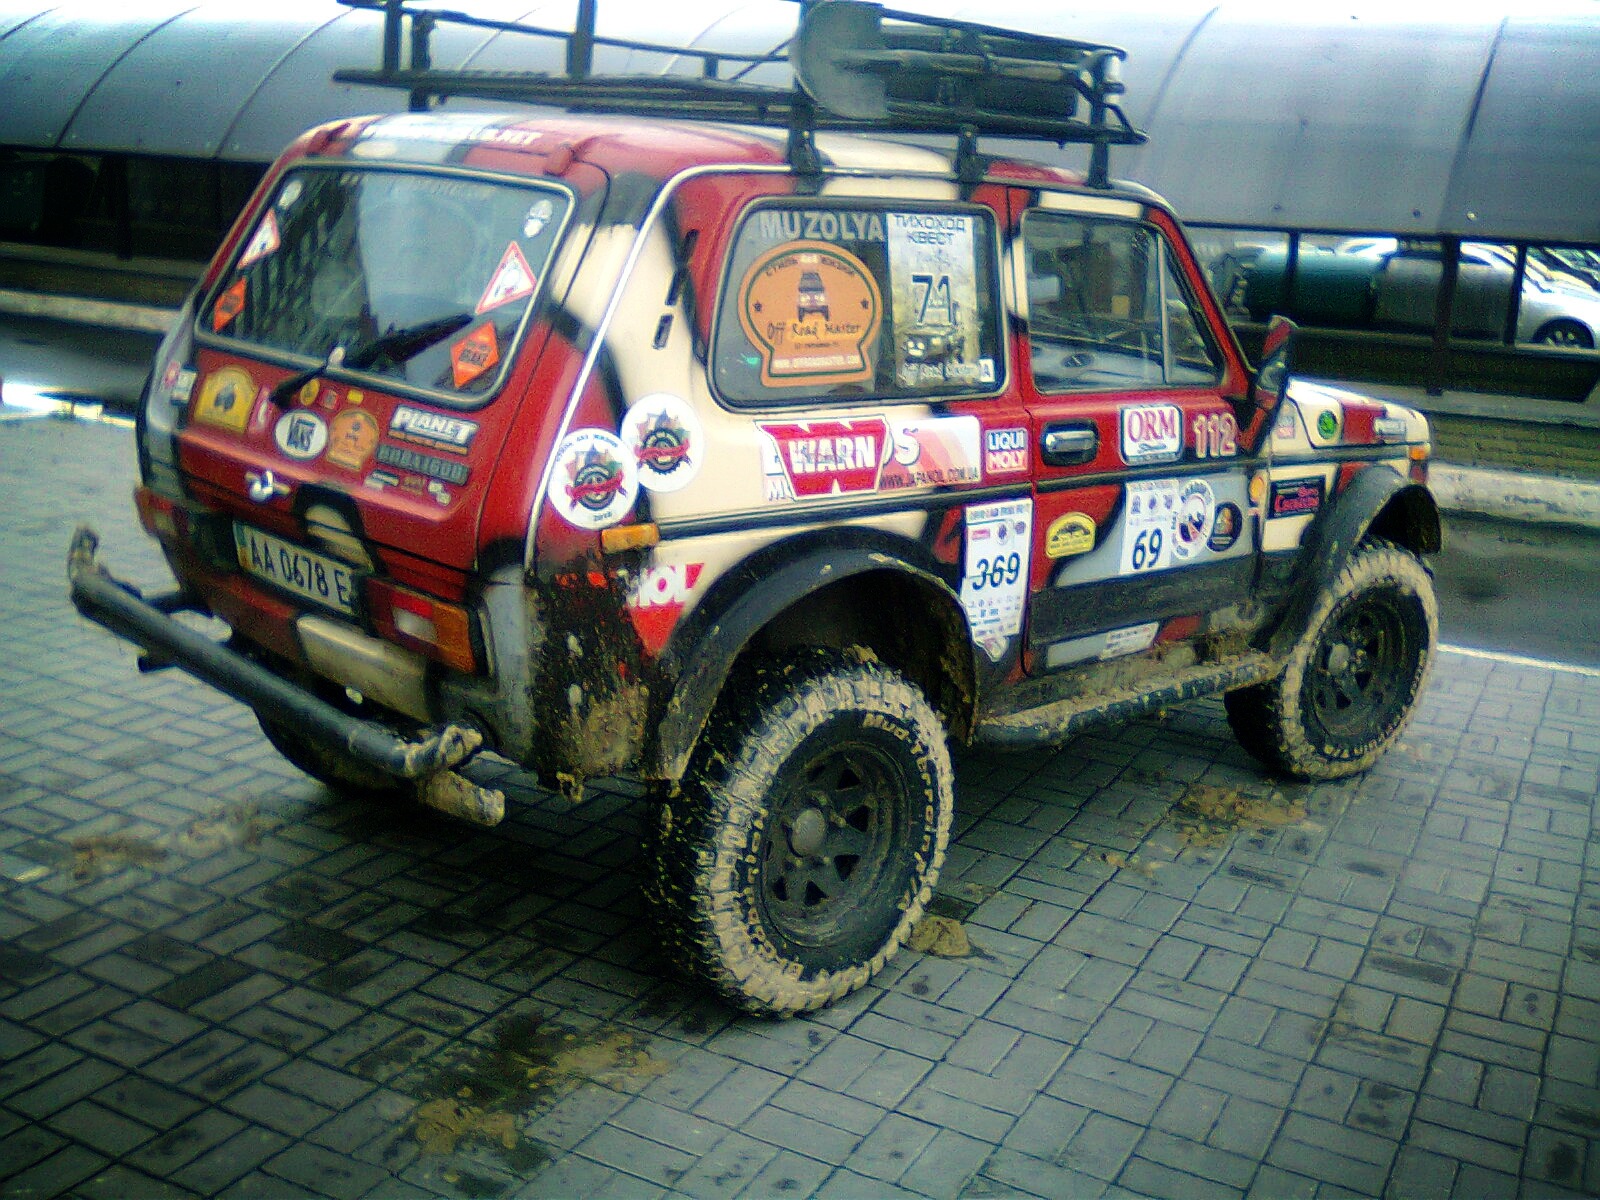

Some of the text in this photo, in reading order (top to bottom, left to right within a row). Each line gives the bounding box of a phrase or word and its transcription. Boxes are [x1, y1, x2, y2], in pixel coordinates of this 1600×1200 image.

[759, 210, 886, 240] MUZOLYA
[911, 274, 951, 322] 71
[988, 431, 1025, 451] LIQUI
[1128, 408, 1177, 443] ORM
[1193, 412, 1236, 459] 112
[788, 435, 876, 473] WARN
[988, 451, 1025, 470] MOLY
[1132, 527, 1163, 570] 69
[250, 534, 352, 606] AA 0678 E
[972, 551, 1021, 591] 369
